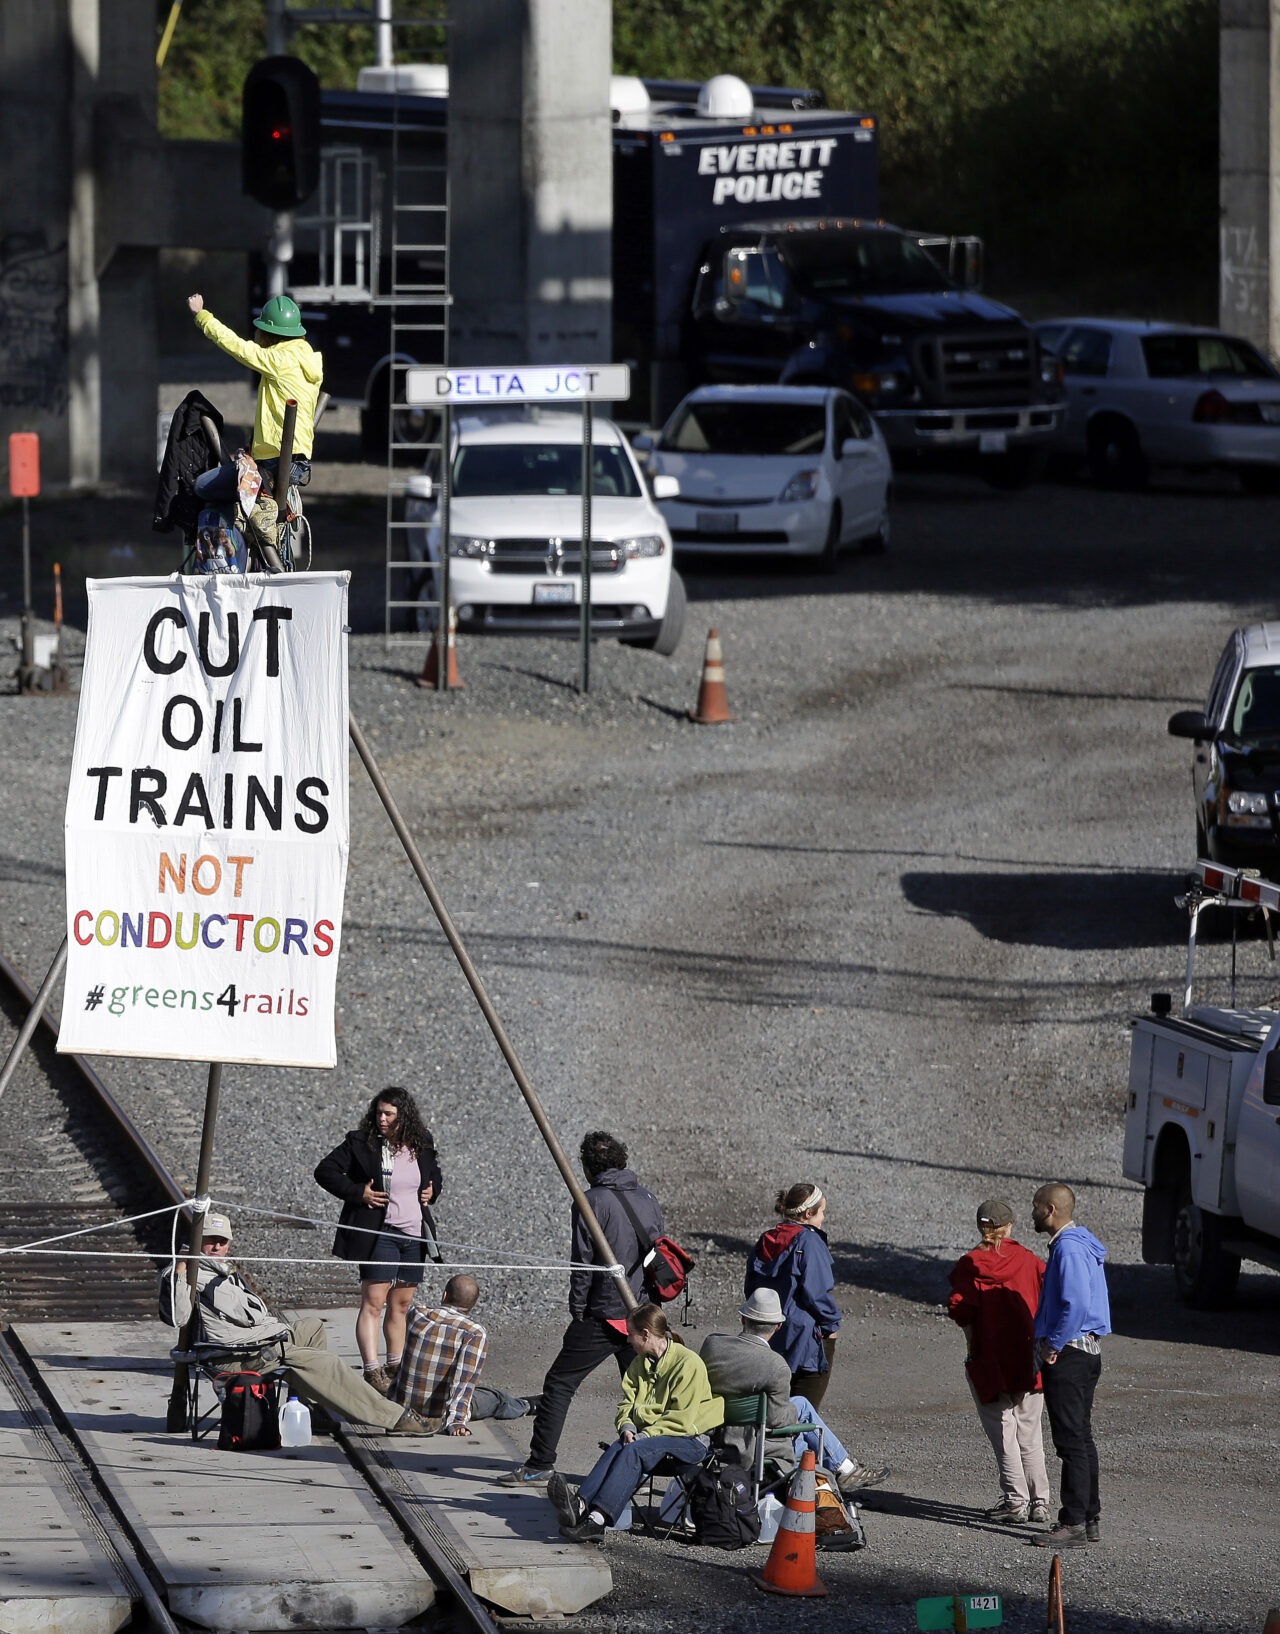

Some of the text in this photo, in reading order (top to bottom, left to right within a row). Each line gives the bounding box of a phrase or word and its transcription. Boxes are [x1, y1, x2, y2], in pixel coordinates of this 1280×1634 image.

[698, 139, 837, 175] EVERETT
[712, 170, 823, 205] POLICE
[436, 372, 599, 396] DELTA JCT
[144, 606, 292, 677] CUT
[162, 694, 262, 753] OIL
[86, 766, 330, 834] TRAINS
[158, 852, 253, 897] NOT
[73, 909, 335, 957] CONDUCTORS
[84, 983, 309, 1017] #greens4rails
[972, 1598, 997, 1609] 1421
